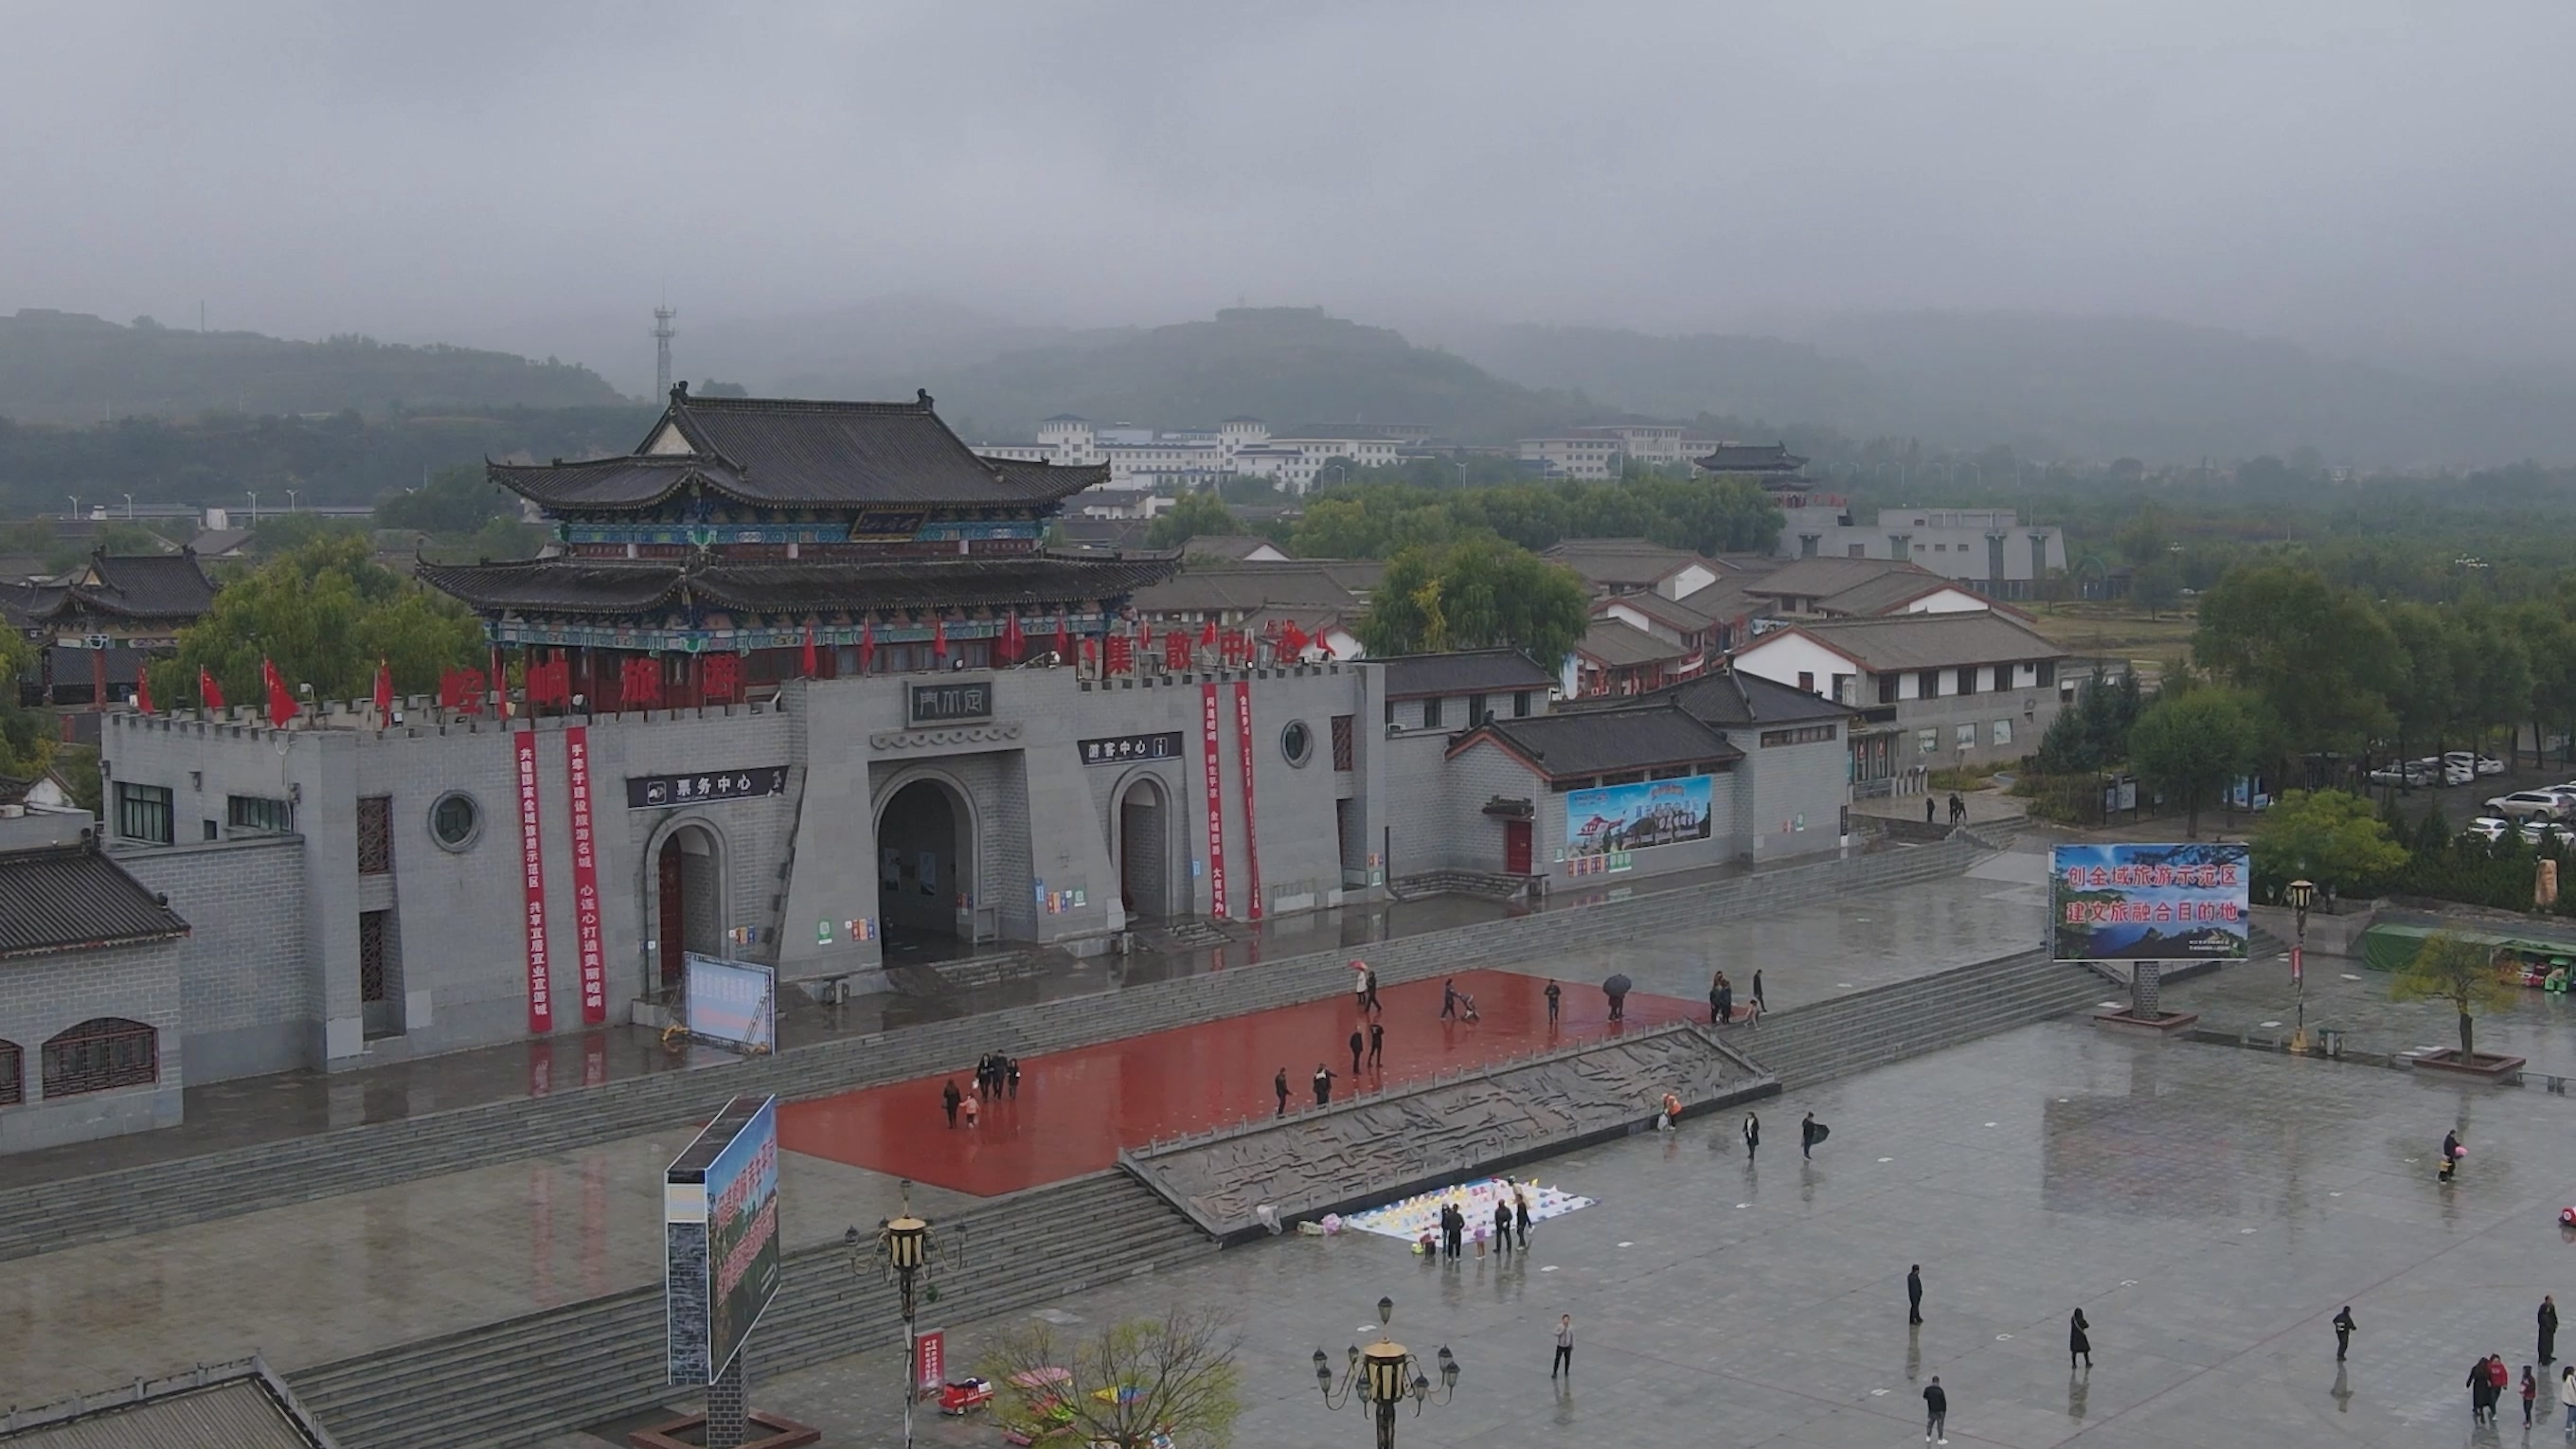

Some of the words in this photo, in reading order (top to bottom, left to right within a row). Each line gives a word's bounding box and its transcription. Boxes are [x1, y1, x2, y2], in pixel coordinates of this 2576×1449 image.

[1088, 740, 1146, 757] 游客中心
[571, 744, 592, 868] 手牵手建设旅游名城
[677, 774, 751, 796] 票务中心
[520, 747, 539, 887] 共建国家全域旅游示范区
[1213, 868, 1224, 913] 大有可为
[2067, 865, 2238, 887] 创全域旅游示范区
[2066, 902, 2240, 924] 建文旅融合目的地
[529, 901, 548, 1016] 共享宜居宜业宜游城
[581, 884, 601, 1007] 心连心打造美丽崆峒
